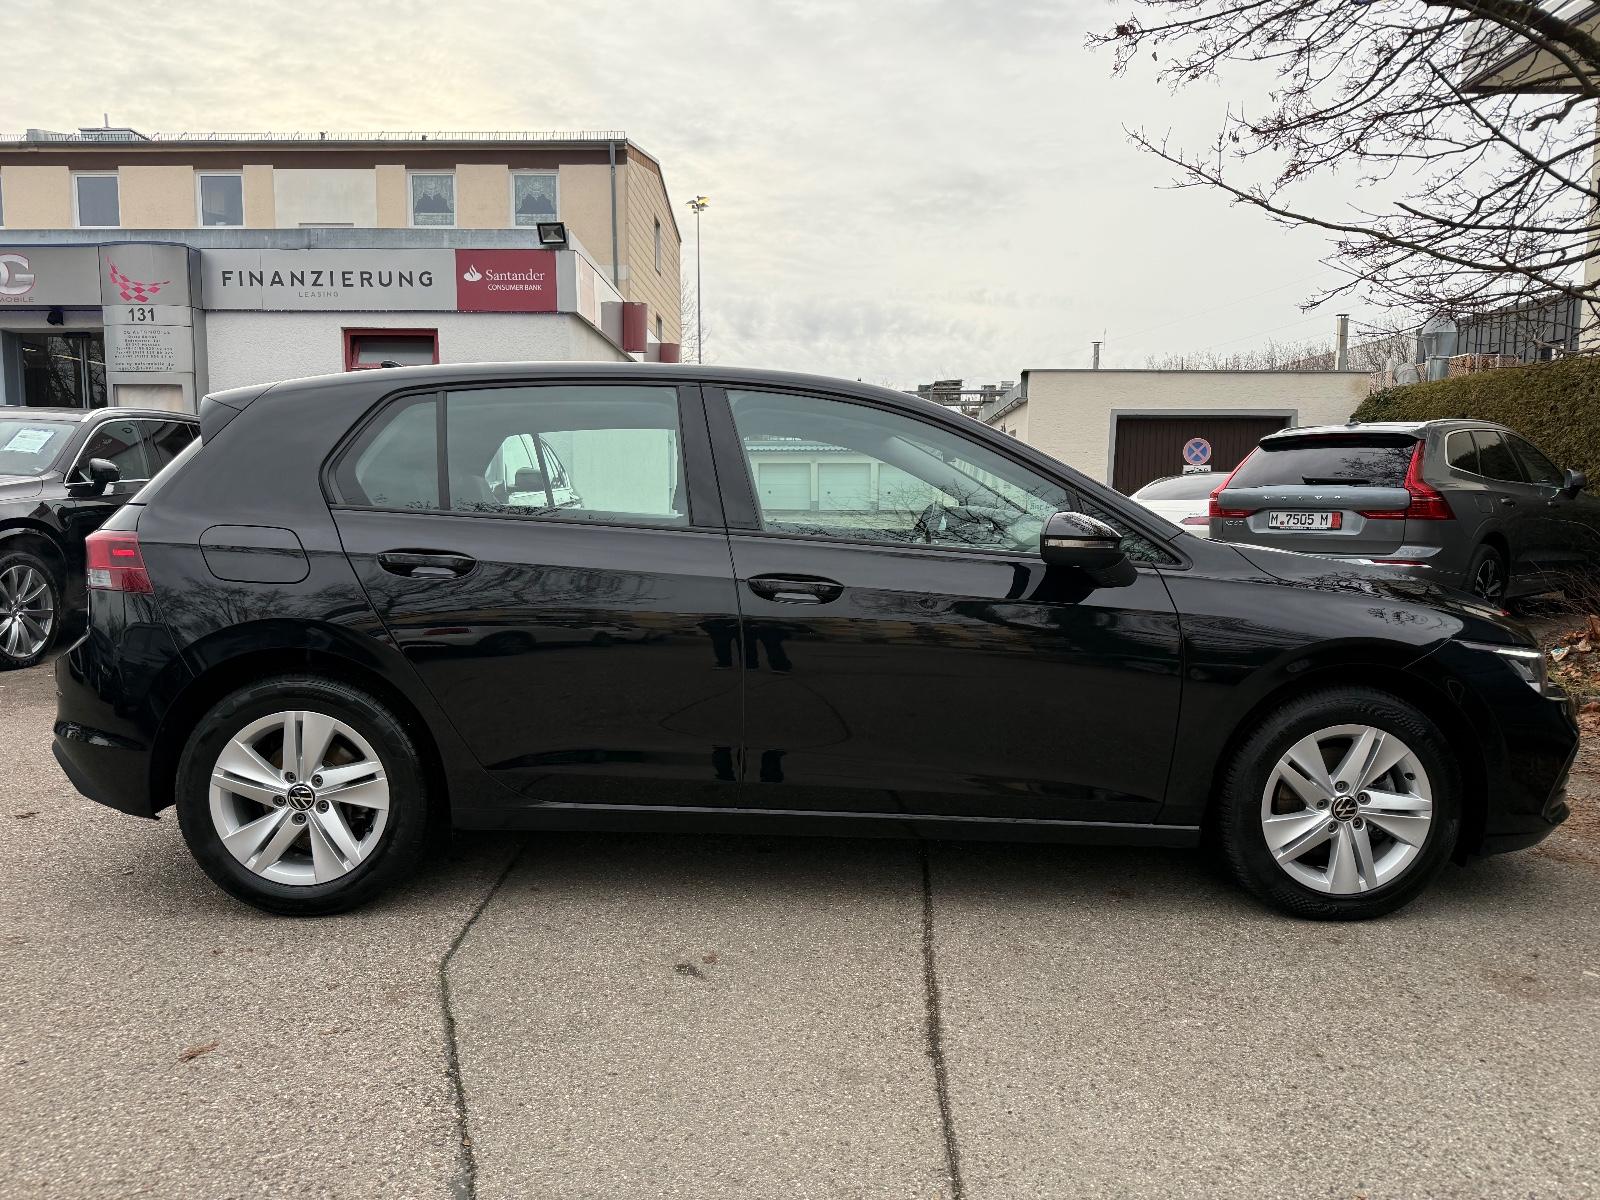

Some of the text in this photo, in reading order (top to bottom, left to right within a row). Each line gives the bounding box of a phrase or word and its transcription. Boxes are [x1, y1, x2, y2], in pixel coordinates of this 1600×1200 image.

[221, 270, 434, 288] FINANZIERUNG
[485, 268, 545, 281] Santander
[487, 283, 524, 291] CONSUMER
[128, 307, 155, 322] 131
[1270, 513, 1329, 526] M 7505 M
